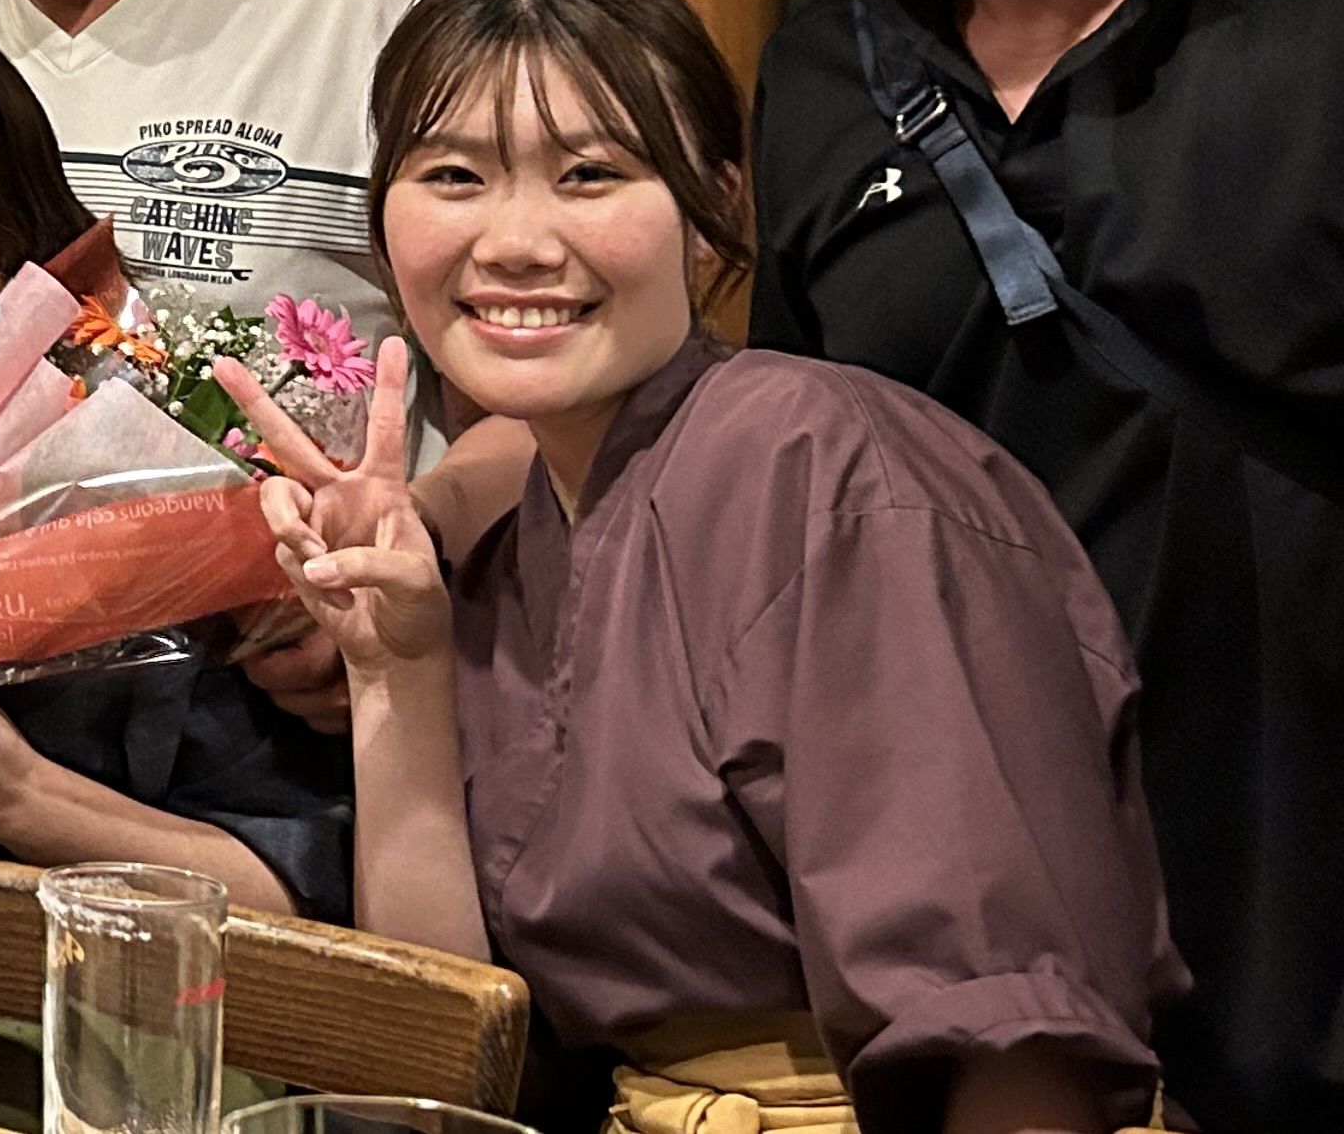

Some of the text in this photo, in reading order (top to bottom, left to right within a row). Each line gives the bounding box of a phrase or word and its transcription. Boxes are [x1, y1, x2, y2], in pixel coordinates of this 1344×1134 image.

[139, 119, 283, 149] PIKO SPREAD ALOHA
[142, 232, 233, 268] WAVES
[120, 491, 226, 516] Mangeons
